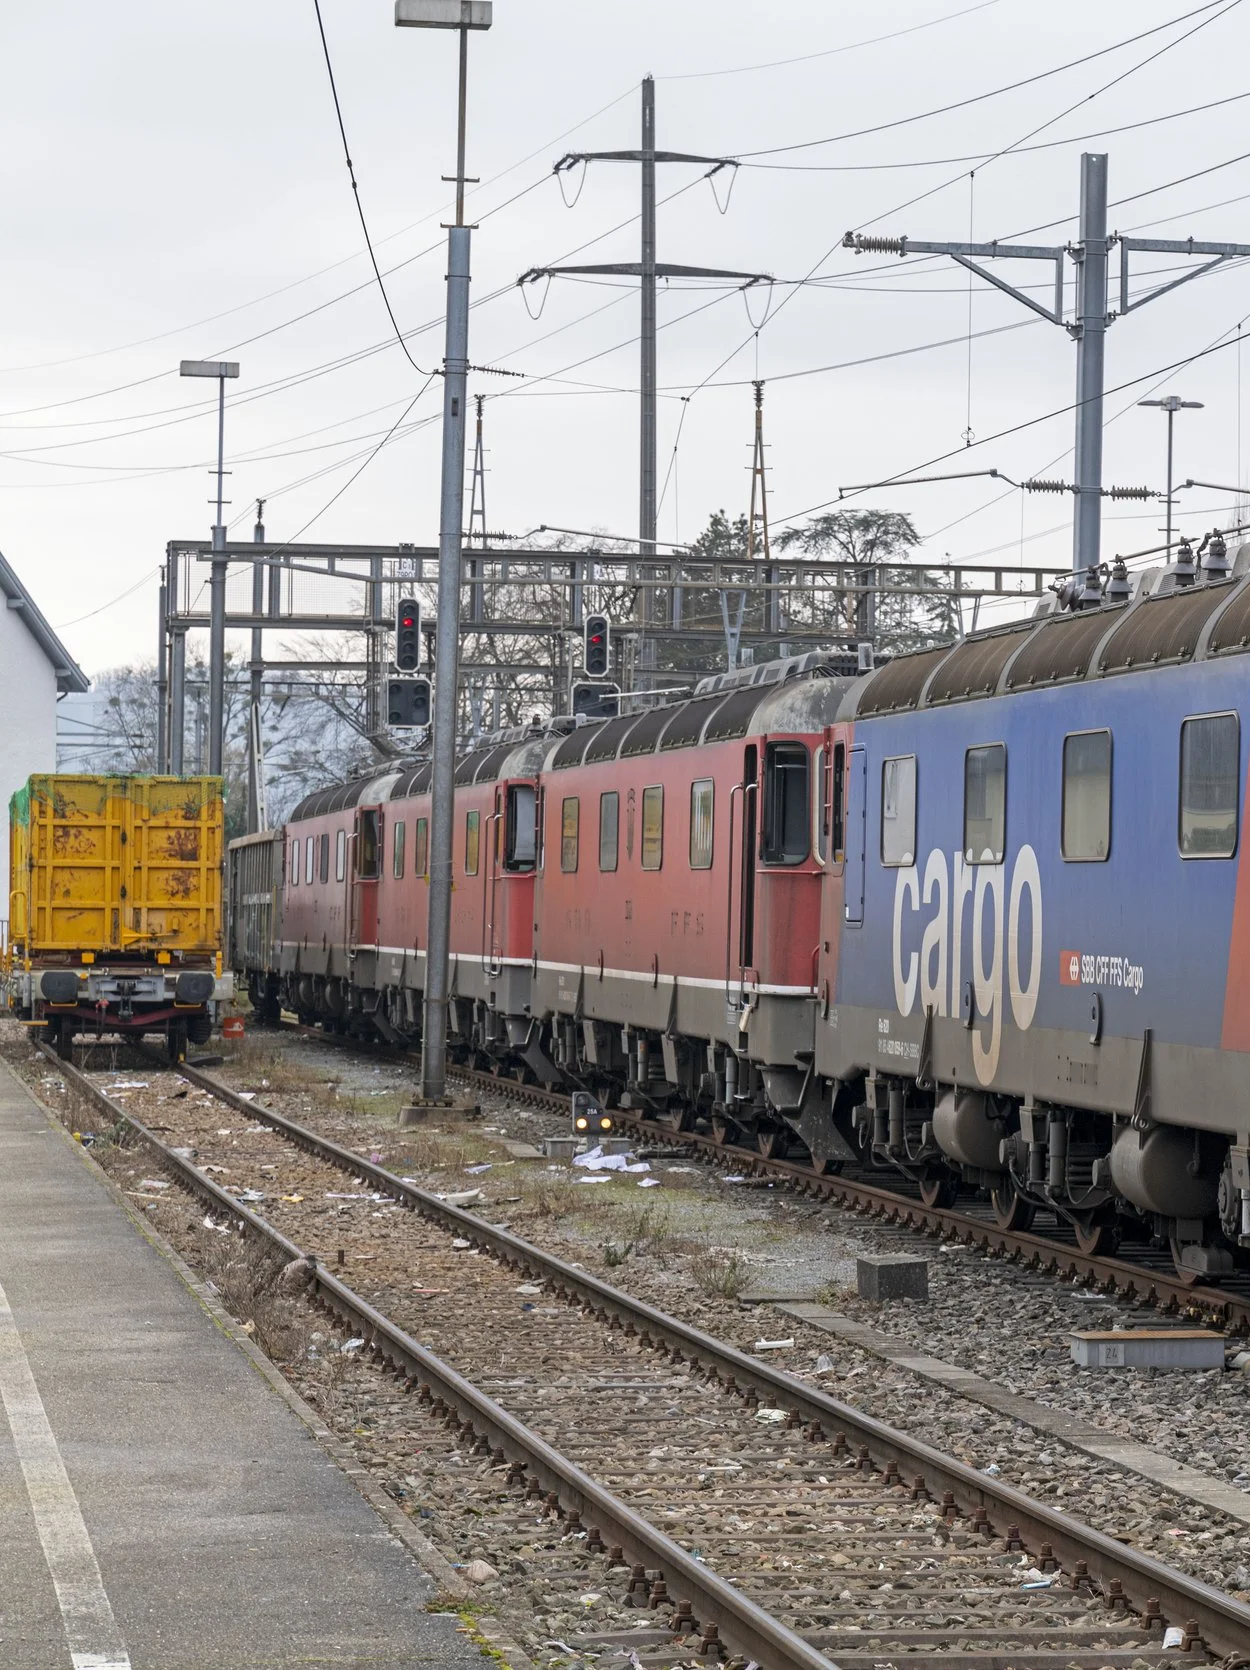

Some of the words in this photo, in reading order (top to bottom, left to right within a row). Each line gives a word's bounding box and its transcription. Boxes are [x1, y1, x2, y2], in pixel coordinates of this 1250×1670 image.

[893, 844, 1042, 1086] cargo
[1081, 954, 1095, 984] SBB
[1095, 955, 1109, 985] CFF
[1109, 956, 1122, 987] FFS
[1123, 957, 1144, 996] Cargo
